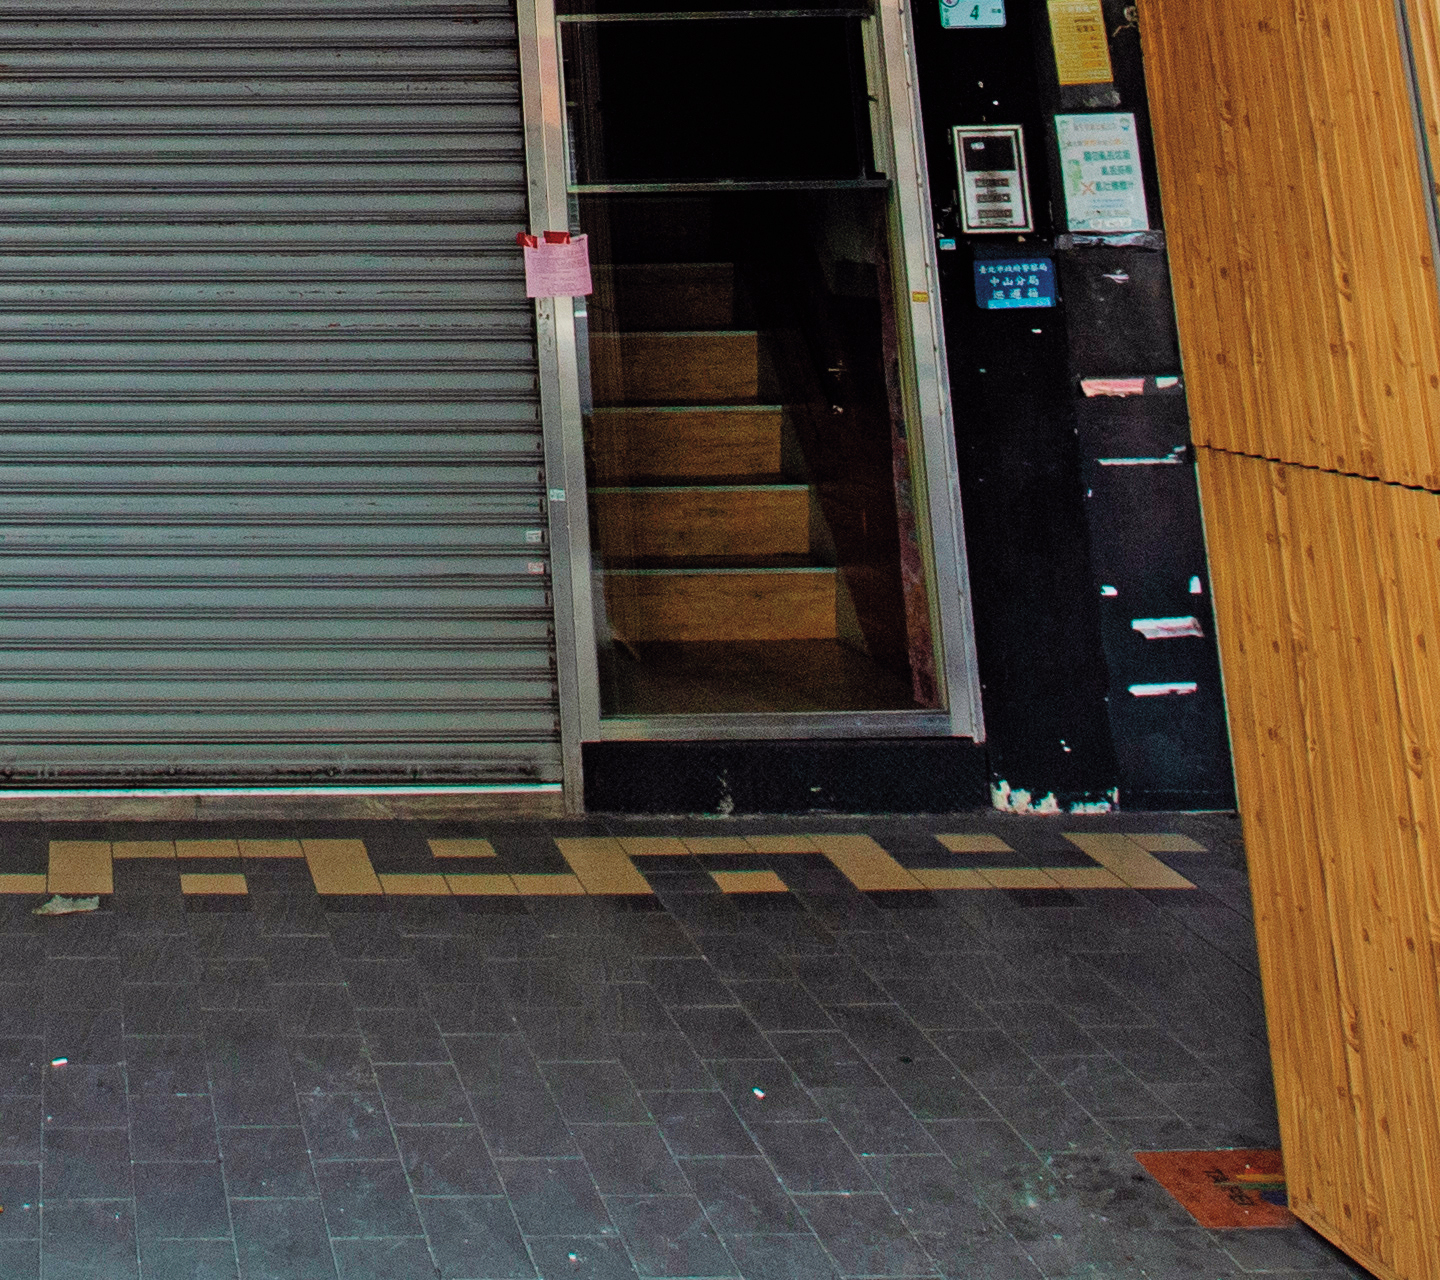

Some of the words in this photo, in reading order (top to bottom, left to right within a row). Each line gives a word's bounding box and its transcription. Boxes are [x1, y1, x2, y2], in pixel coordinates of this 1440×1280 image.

[970, 4, 979, 20] 4
[989, 274, 1040, 288] 中山分局
